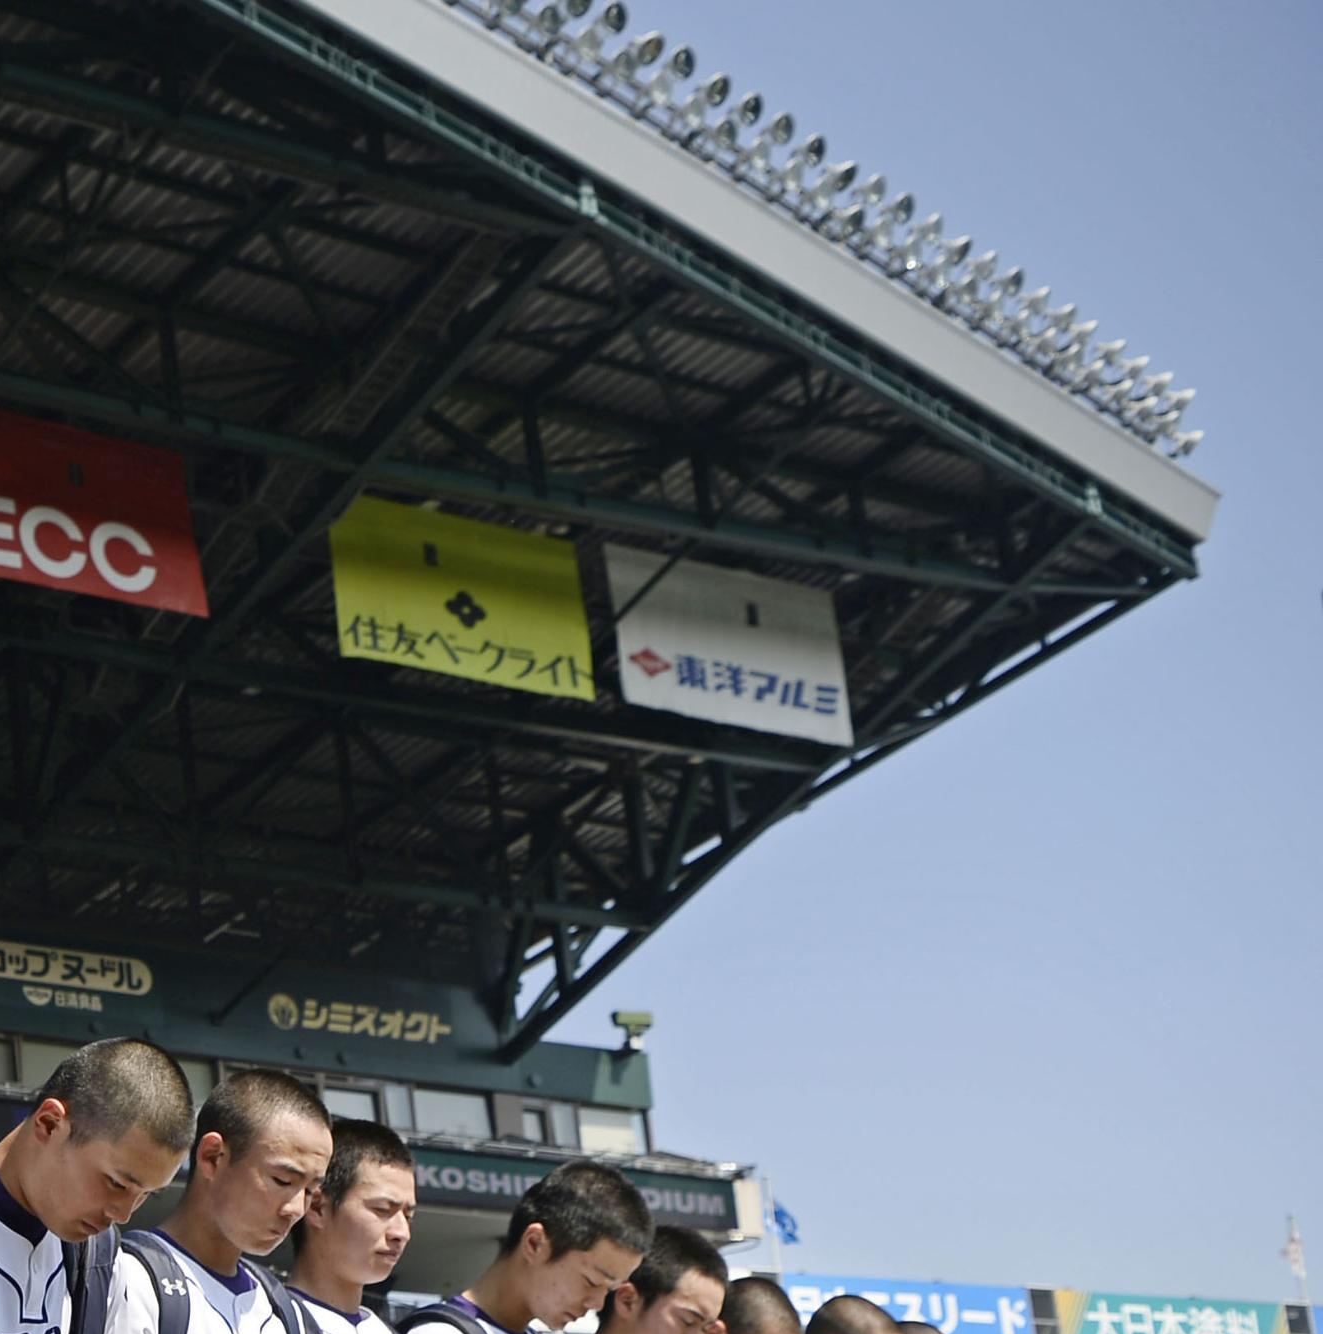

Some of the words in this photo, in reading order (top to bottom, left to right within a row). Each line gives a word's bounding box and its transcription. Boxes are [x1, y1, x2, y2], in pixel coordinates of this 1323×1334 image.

[343, 614, 593, 690] 住友ベークライト
[676, 654, 841, 715] 東洋アルミ
[302, 999, 452, 1044] シミズオクト
